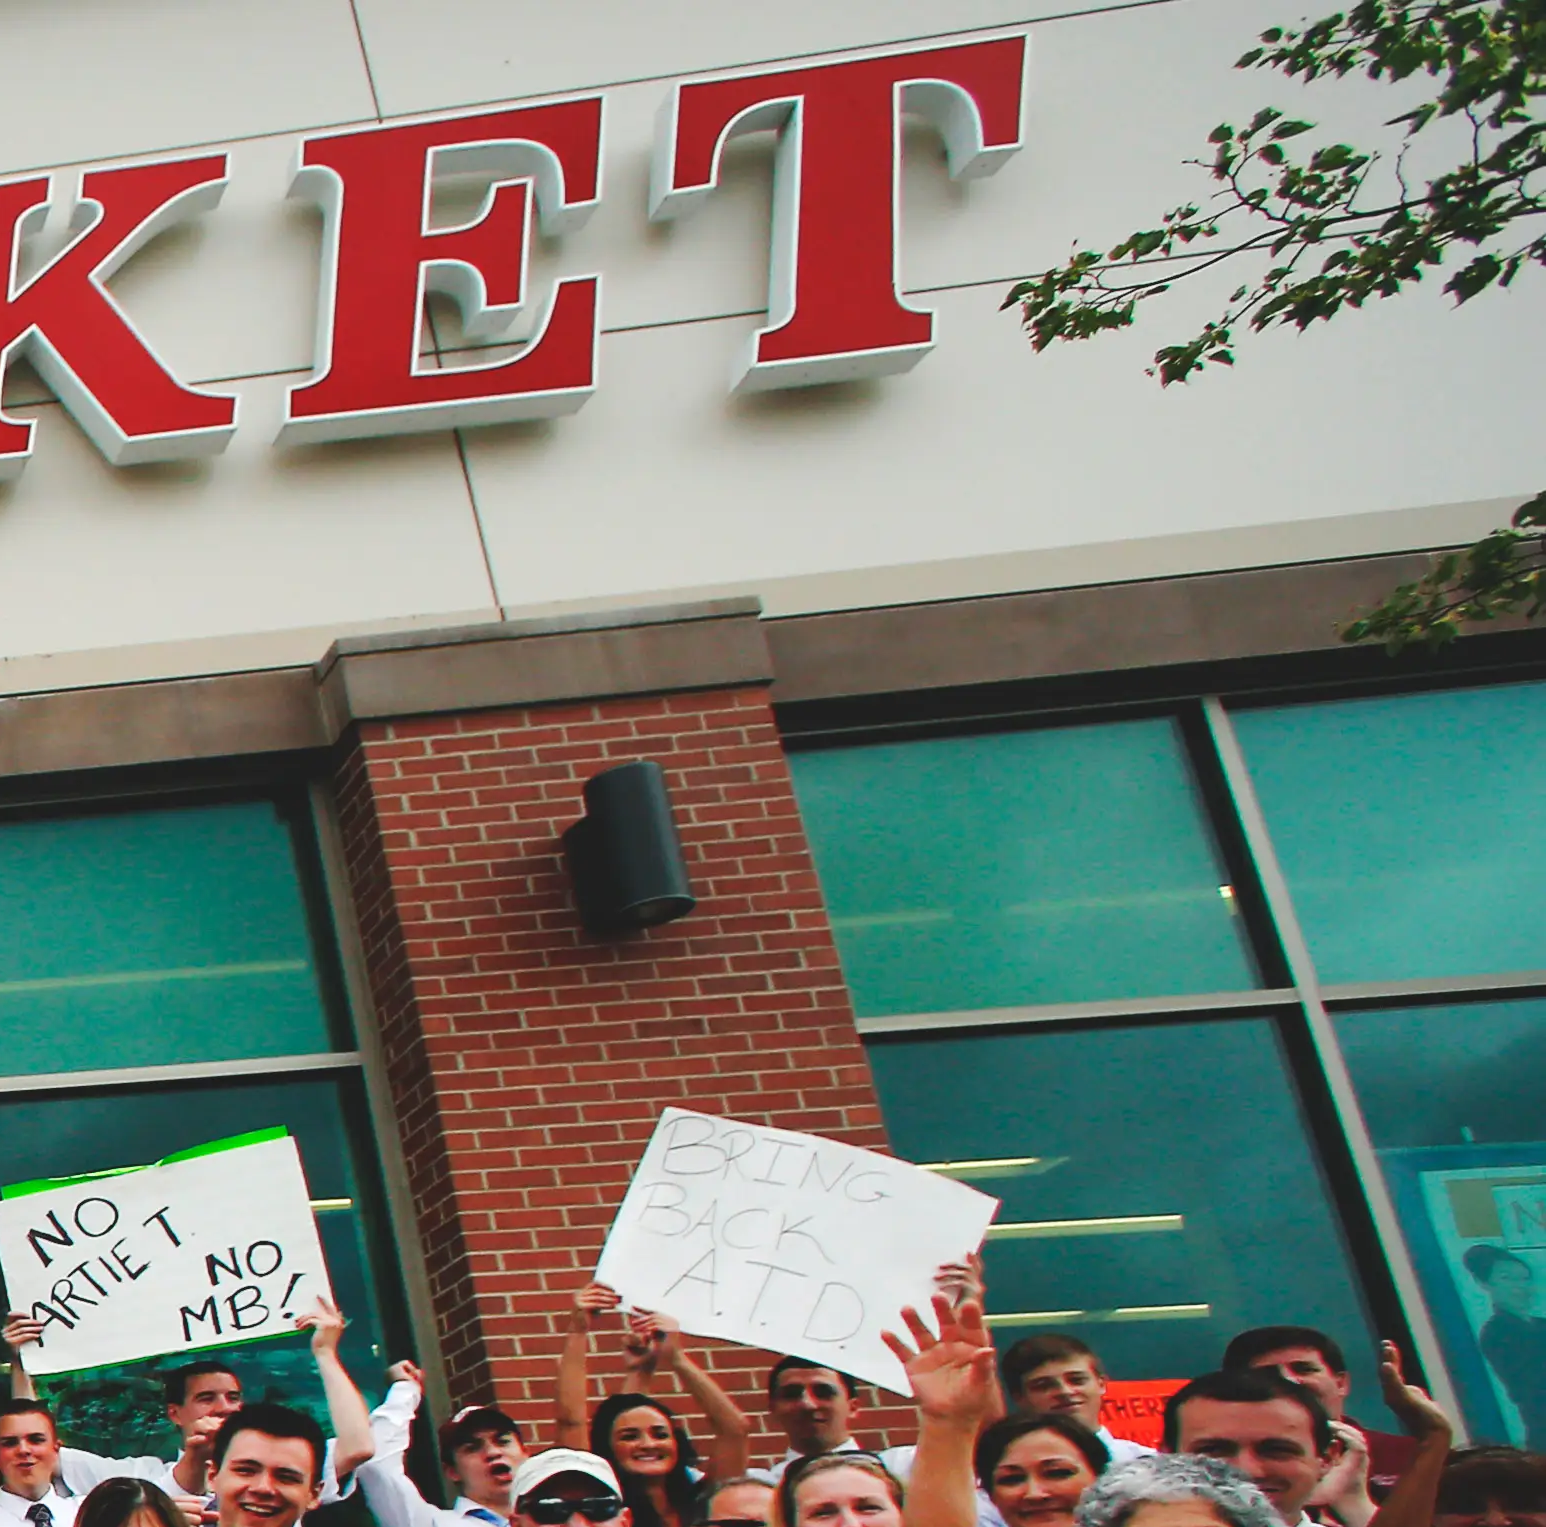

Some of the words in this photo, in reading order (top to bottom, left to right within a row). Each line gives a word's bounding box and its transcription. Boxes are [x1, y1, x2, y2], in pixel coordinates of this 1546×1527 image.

[663, 1116, 893, 1202] BRING
[26, 1197, 119, 1268] NO
[637, 1182, 836, 1265] BACK
[30, 1238, 151, 1348] ARTIE
[205, 1240, 283, 1286] NO
[179, 1272, 307, 1342] MB!
